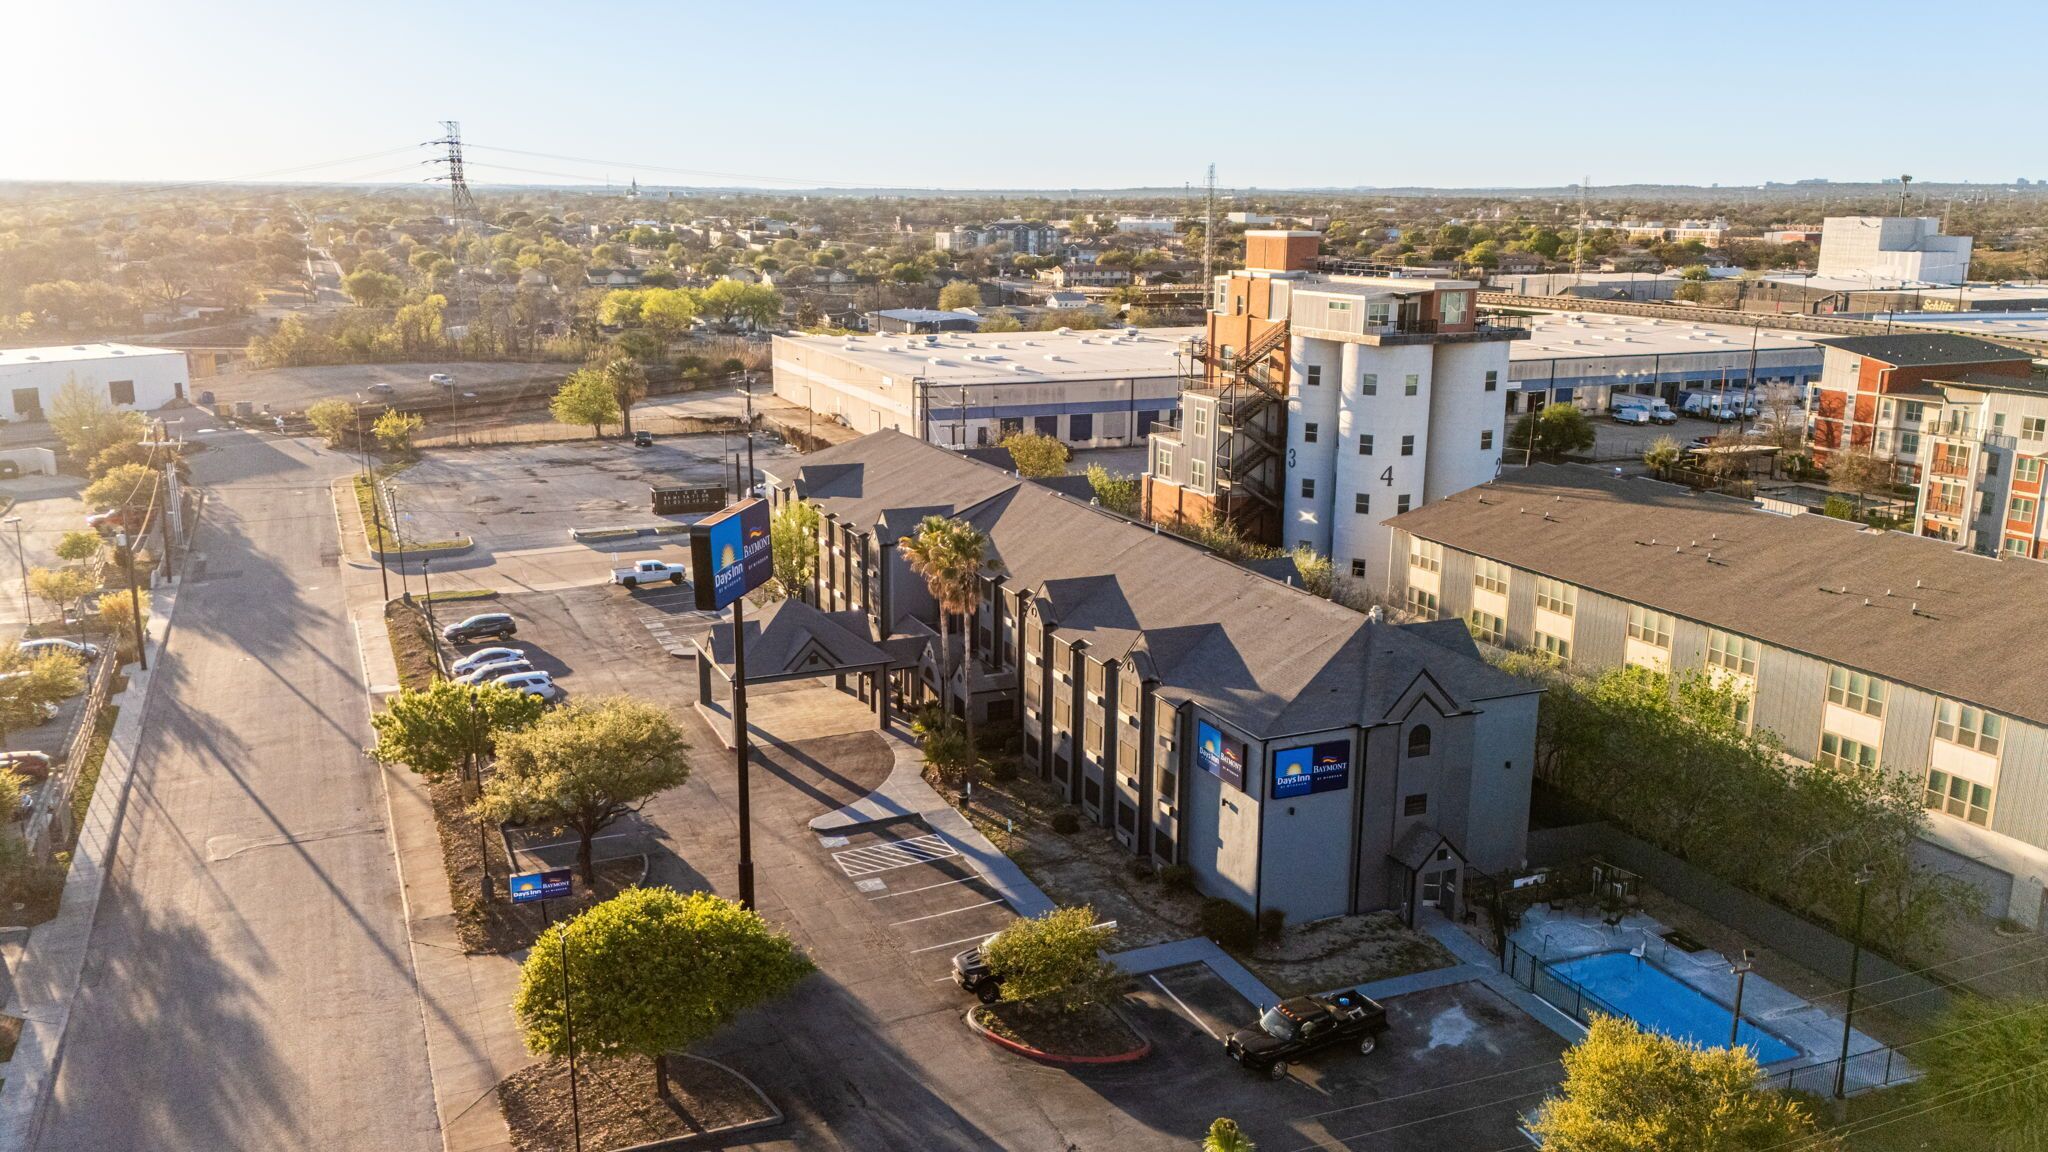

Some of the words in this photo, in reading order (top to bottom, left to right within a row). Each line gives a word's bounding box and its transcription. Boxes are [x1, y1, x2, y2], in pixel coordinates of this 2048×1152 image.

[1922, 299, 1955, 312] Schlitz
[1288, 448, 1296, 469] 3
[1494, 457, 1502, 478] 2
[1379, 465, 1394, 487] 4
[743, 534, 771, 559] BAYMONT
[715, 571, 731, 588] Days
[731, 562, 744, 577] Inn
[1199, 746, 1211, 760] Days
[1220, 752, 1242, 771] BAYMONT
[1313, 762, 1347, 774] BAYMONT
[1277, 776, 1297, 786] Days
[1297, 774, 1311, 783] Inn
[542, 881, 569, 889] BAYMONT
